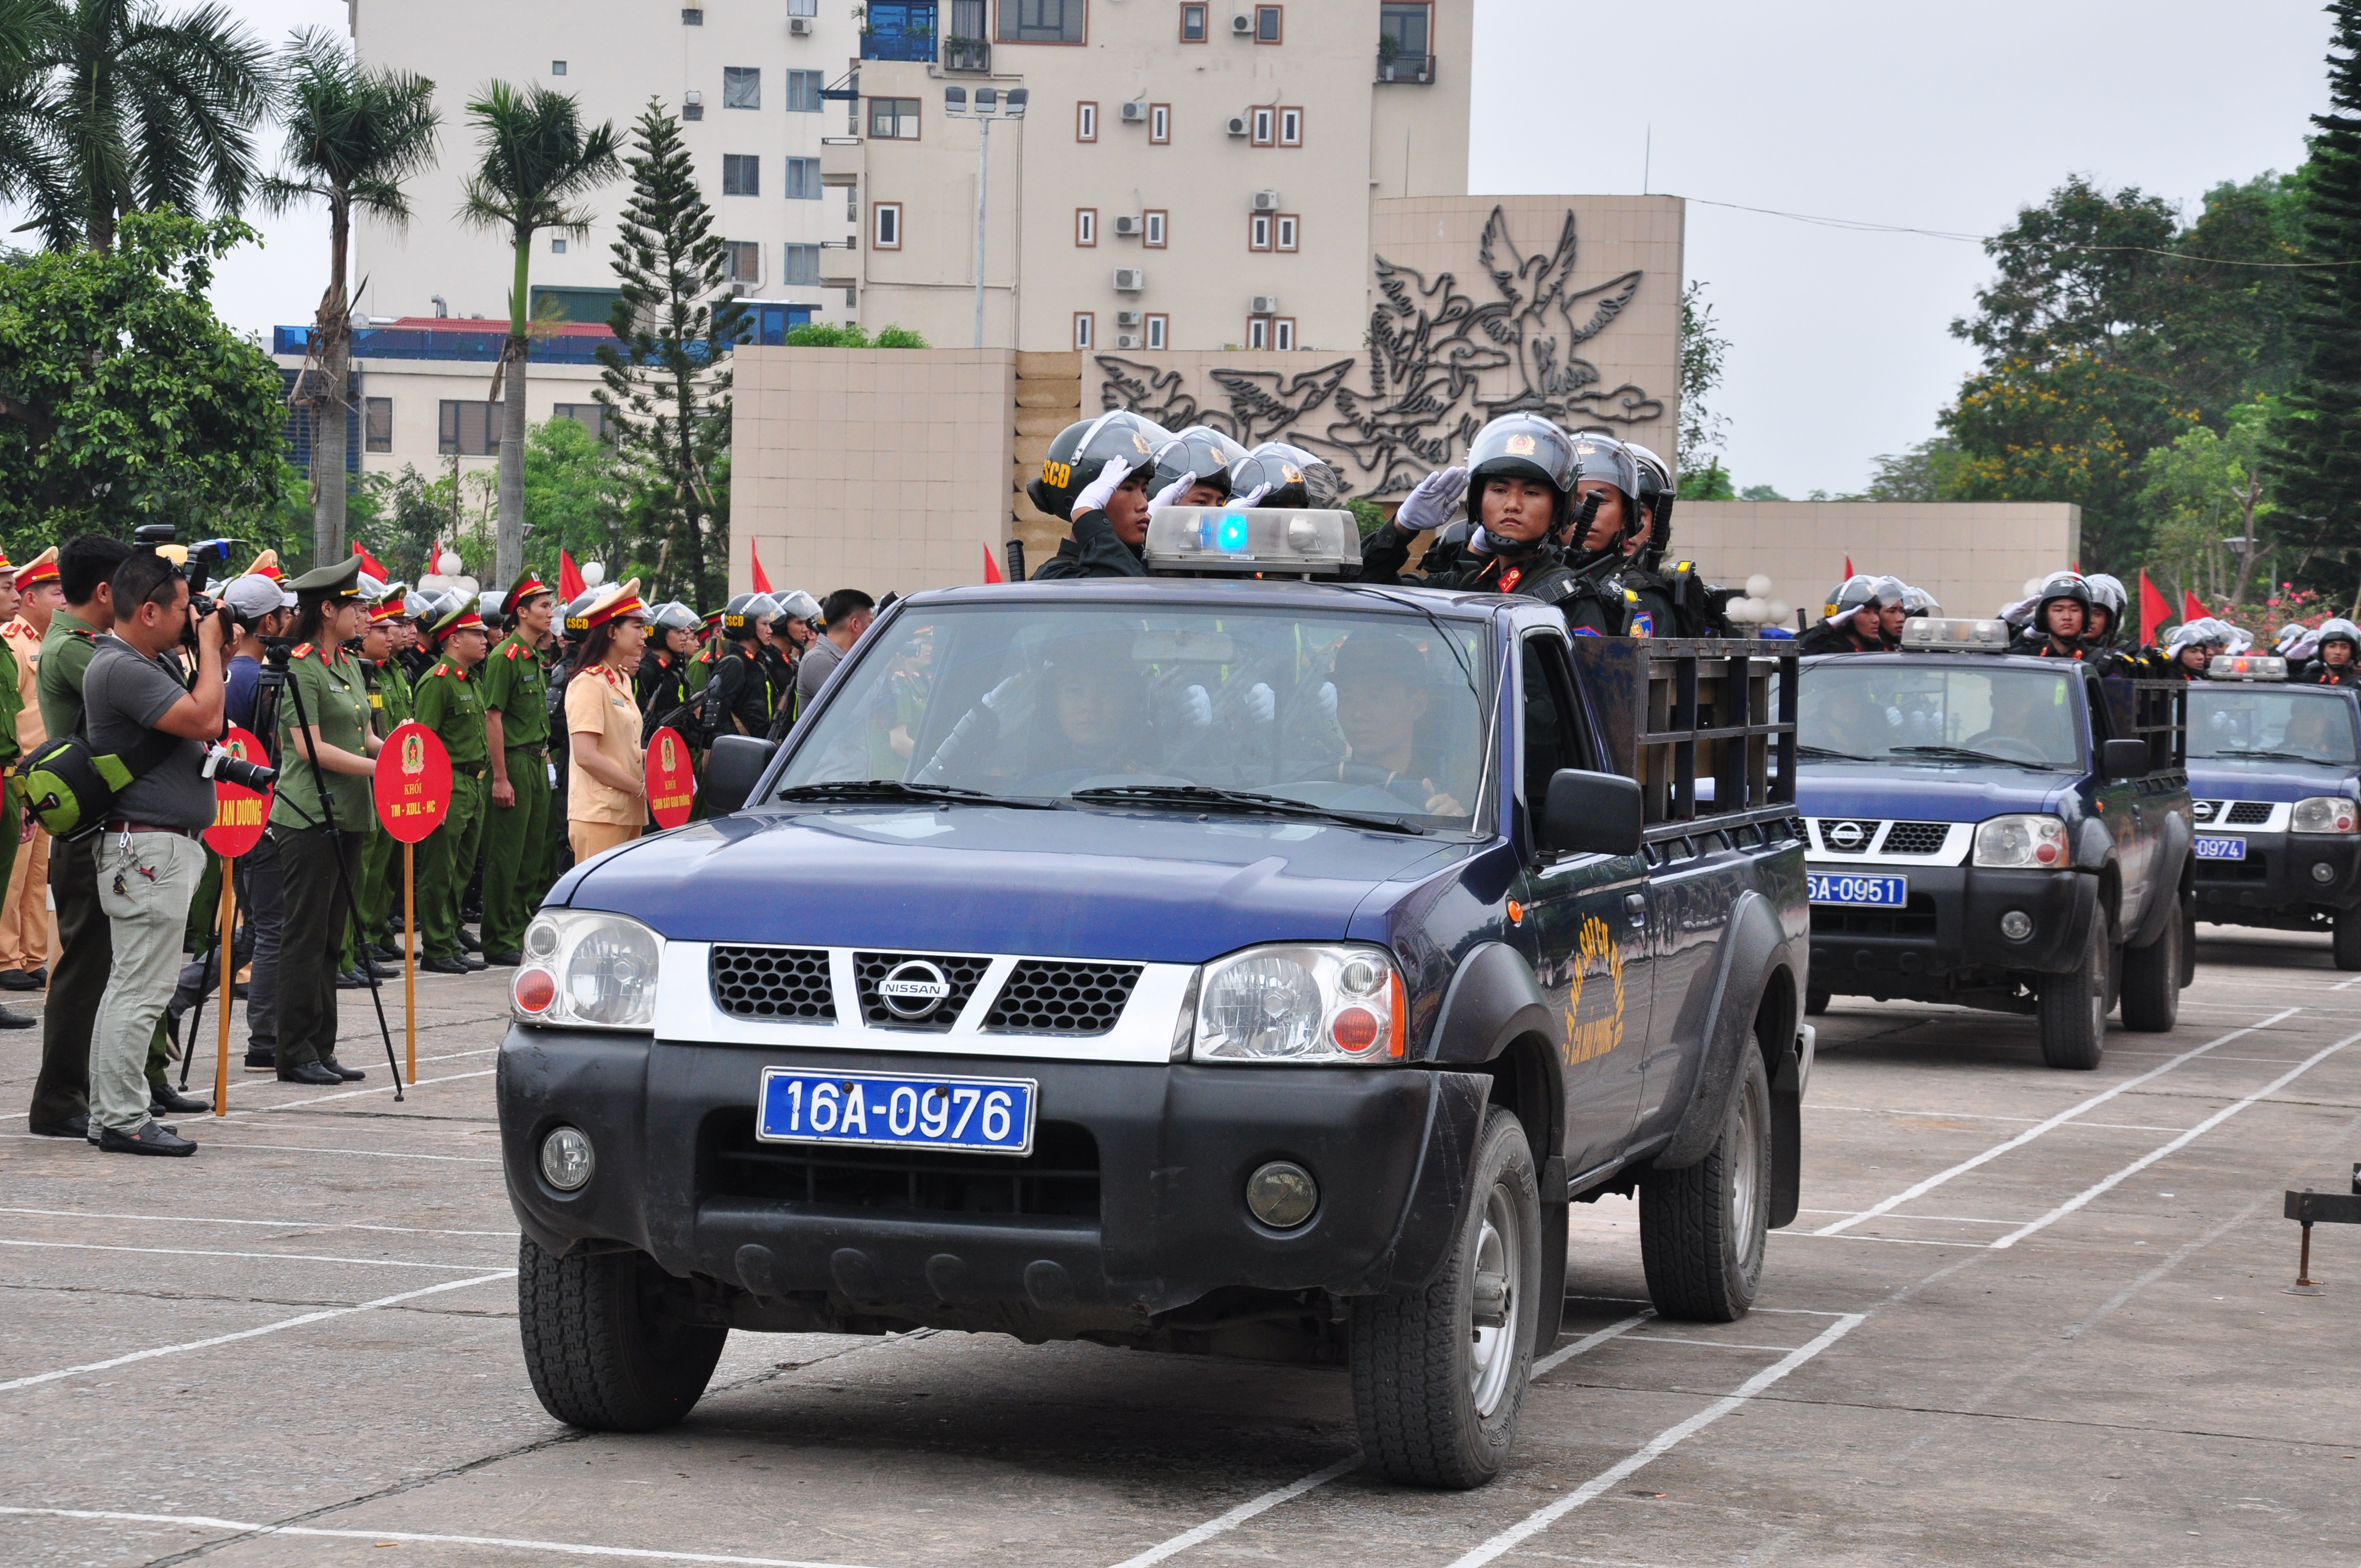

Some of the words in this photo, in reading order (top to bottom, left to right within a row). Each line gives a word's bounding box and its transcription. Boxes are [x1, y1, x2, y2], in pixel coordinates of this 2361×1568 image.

[1043, 460, 1070, 488] SCĐ
[404, 778, 422, 795] KHỐI
[665, 776, 676, 790] KHỐI
[222, 799, 235, 826] AN
[236, 797, 262, 826] DƯƠNG
[391, 804, 401, 818] TM
[406, 802, 421, 816] XDLL
[426, 799, 436, 813] HC
[2195, 840, 2239, 857] -0974
[1808, 876, 1895, 903] 6A-0951
[1579, 912, 1597, 970] SÁT
[885, 983, 941, 994] NISSAN
[787, 1080, 1013, 1141] 16A-0976
